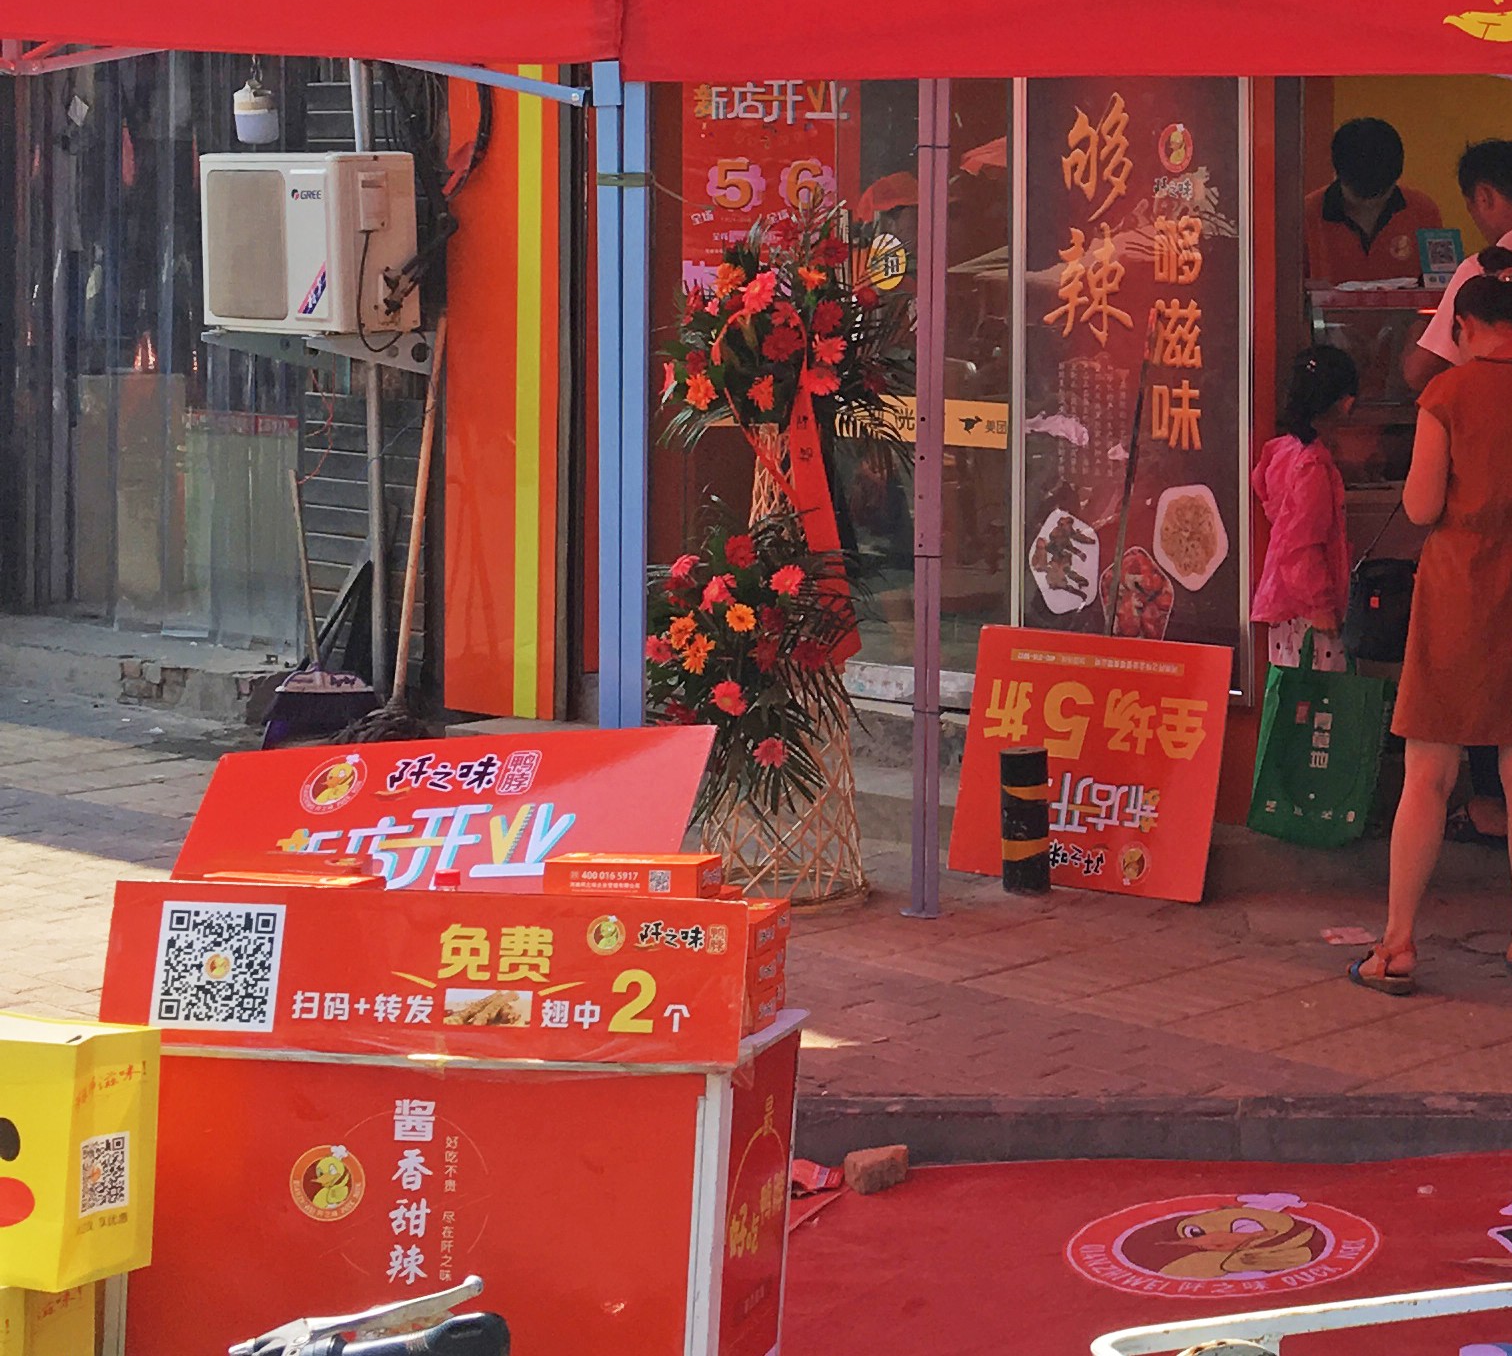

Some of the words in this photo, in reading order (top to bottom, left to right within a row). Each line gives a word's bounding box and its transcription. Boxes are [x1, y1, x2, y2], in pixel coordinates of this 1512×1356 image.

[694, 78, 849, 124] 新店开业
[300, 189, 322, 200] GREE
[713, 158, 754, 210] 5
[1152, 215, 1203, 451] 够滋味
[983, 679, 1209, 762] 全场5折
[502, 751, 538, 794] 鸭脖
[1049, 772, 1160, 834] 新店开
[581, 870, 599, 881] 400
[617, 871, 639, 882] 5917
[438, 923, 554, 983] 免费
[291, 990, 435, 1025] 扫码+转发
[386, 1099, 436, 1285] 酱香甜辣
[1280, 1263, 1343, 1288] DUCK
